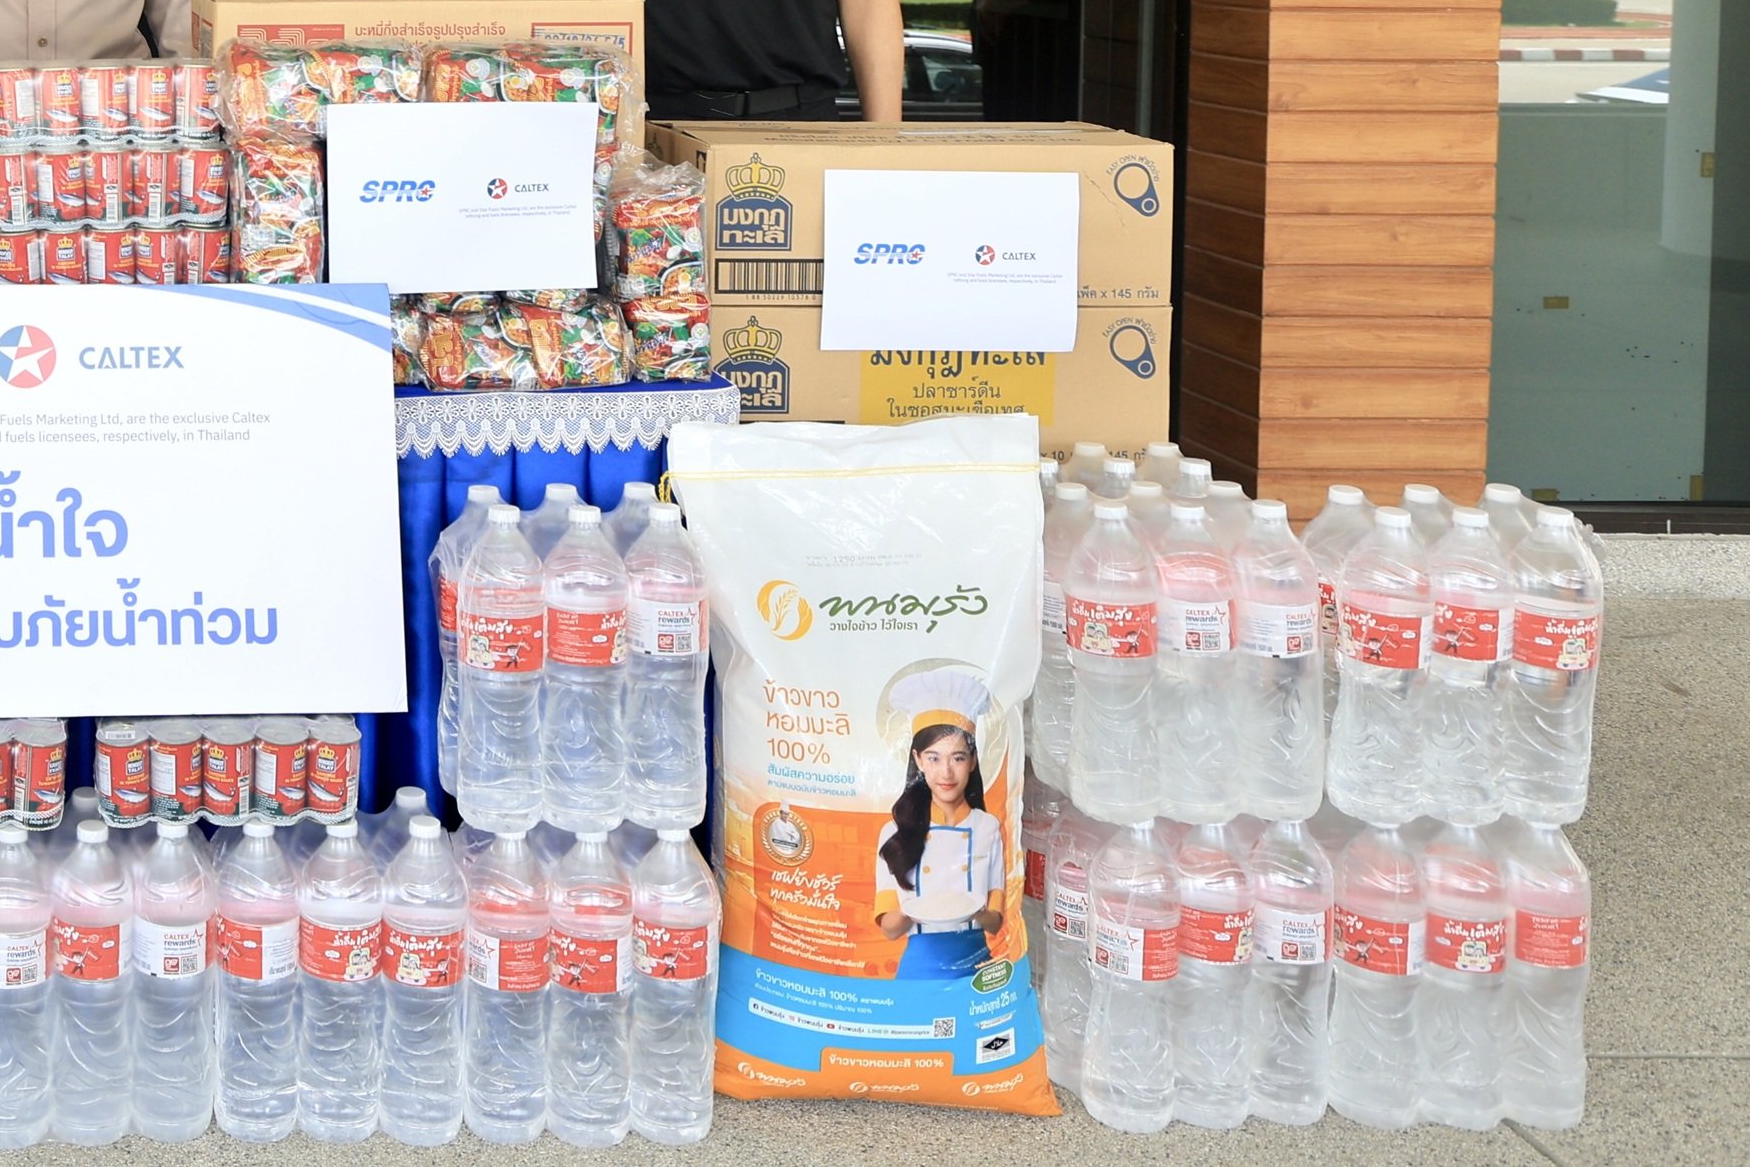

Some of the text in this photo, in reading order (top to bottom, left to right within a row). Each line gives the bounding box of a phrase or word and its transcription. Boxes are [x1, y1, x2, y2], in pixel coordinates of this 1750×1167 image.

[354, 21, 506, 40] บะหมี่กึ่งสำเร็จรูปปรุงสำเร็จ
[1105, 154, 1137, 176] EASY OPEN
[359, 180, 549, 203] SPRC CALTEX
[722, 208, 785, 231] มงกุฎ
[722, 228, 785, 244] ทะเล
[853, 243, 1036, 265] SPRC CALTEX
[1112, 288, 1131, 298] 145
[1137, 286, 1159, 298] กรัม
[1102, 317, 1133, 338] EASY OPEN
[79, 346, 185, 371] CALTEX
[912, 377, 1001, 399] ปลาซาร์ดีน
[0, 414, 32, 426] Fuels
[36, 413, 98, 427] Marketing
[101, 413, 123, 426] Ltd,
[126, 415, 146, 425] are
[149, 413, 169, 424] the
[173, 412, 229, 424] exclusive
[232, 411, 270, 424] Caltex
[5, 431, 35, 443] fuels
[38, 430, 99, 444] licensees,
[103, 429, 180, 444] respectively,
[183, 430, 194, 441] in
[198, 429, 250, 441] Thailand
[819, 584, 988, 633] พนมรุ้ง
[658, 616, 690, 625] rewards
[829, 618, 918, 632] วางใจข้าว ไว้ใจเรา
[762, 679, 840, 709] ข้าวขาว
[765, 711, 850, 736] หอมมะลิ
[766, 737, 831, 765] 100%
[767, 763, 855, 784] สัมผัสความอร่อย
[1282, 918, 1309, 927] CALTEX
[1282, 925, 1317, 935] rewards
[164, 938, 196, 947] rewards
[7, 949, 36, 958] rewards
[755, 968, 826, 998] ข้าวขาวหอมมะลิ
[829, 990, 857, 1003] 100%
[1001, 991, 1010, 1007] 25
[829, 1053, 944, 1068] ข้าวขาวหอมมะลิ 100%
